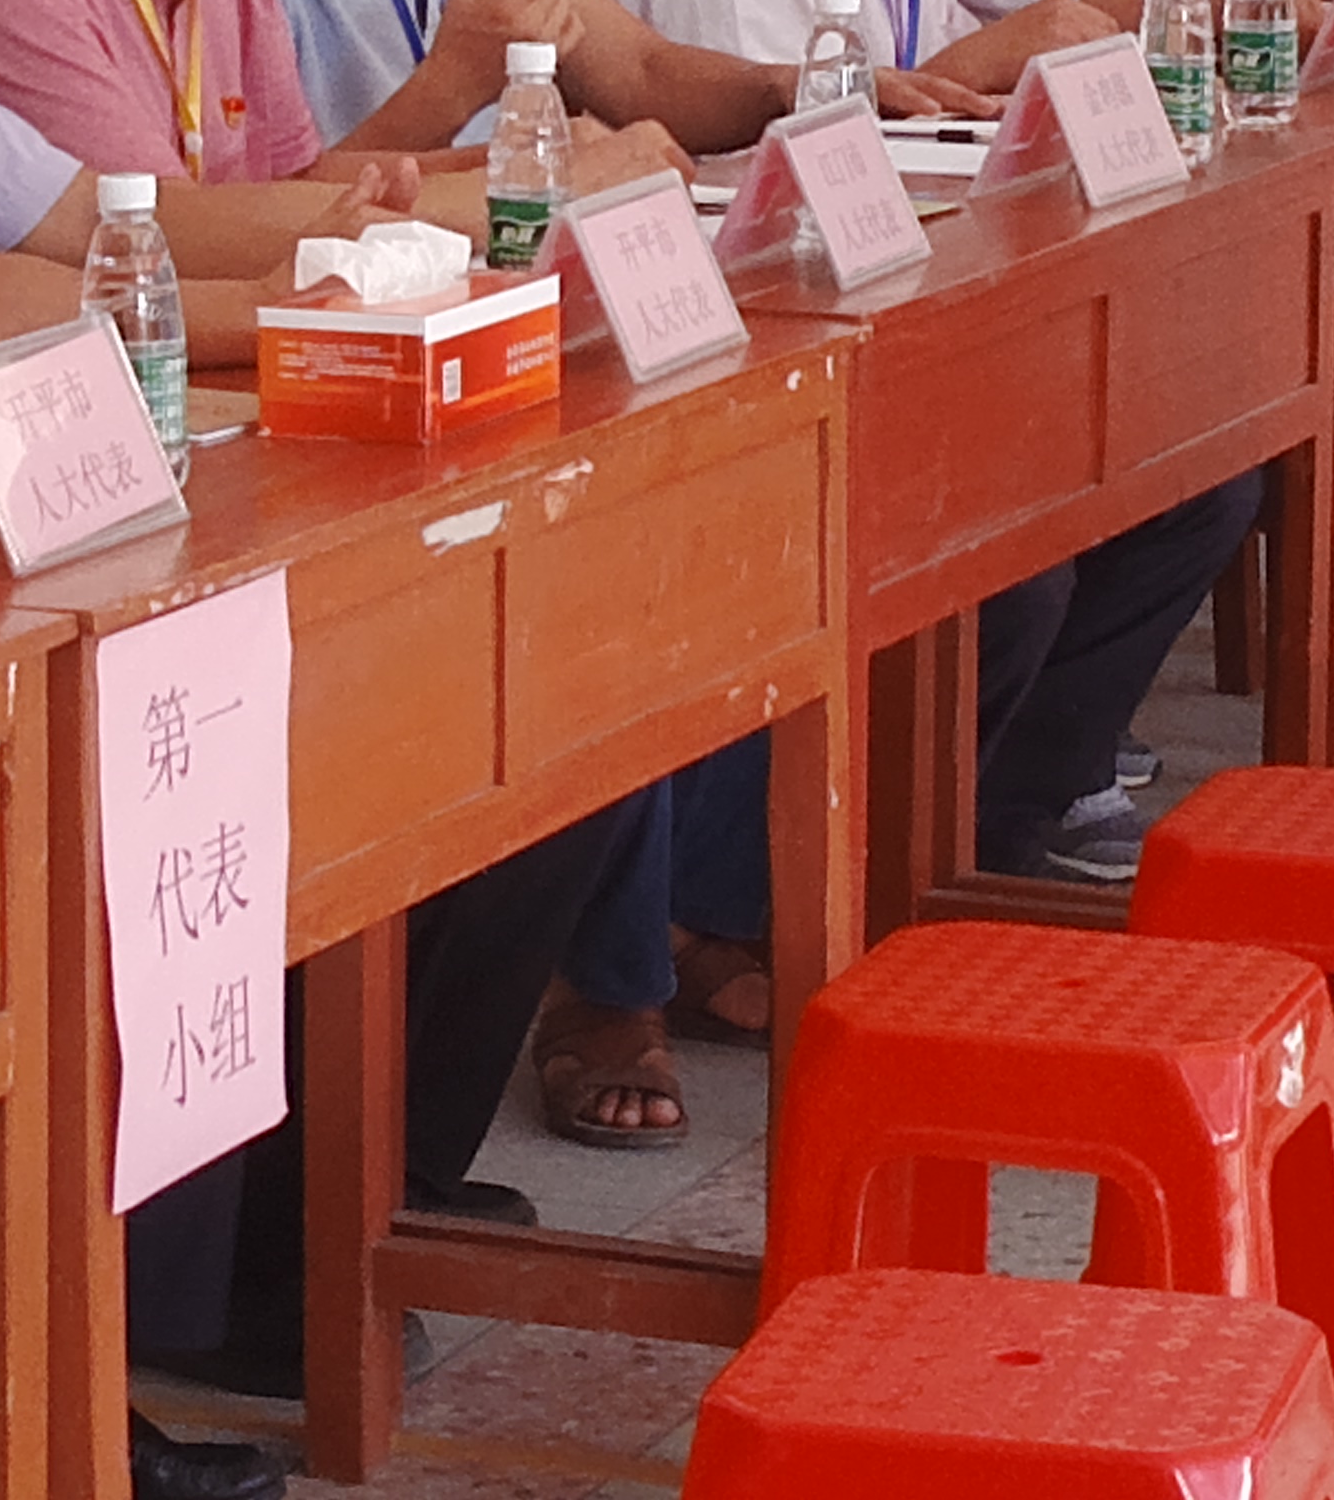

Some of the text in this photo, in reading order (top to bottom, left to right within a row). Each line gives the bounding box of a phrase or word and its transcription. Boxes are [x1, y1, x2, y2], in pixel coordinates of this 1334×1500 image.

[615, 216, 678, 273] 开平市
[635, 279, 716, 346] 人大代表
[5, 368, 94, 445] 开平市
[25, 441, 143, 534] 人大代表
[142, 684, 243, 803] 第一
[148, 822, 250, 958] 代表
[160, 974, 257, 1108] 小组
